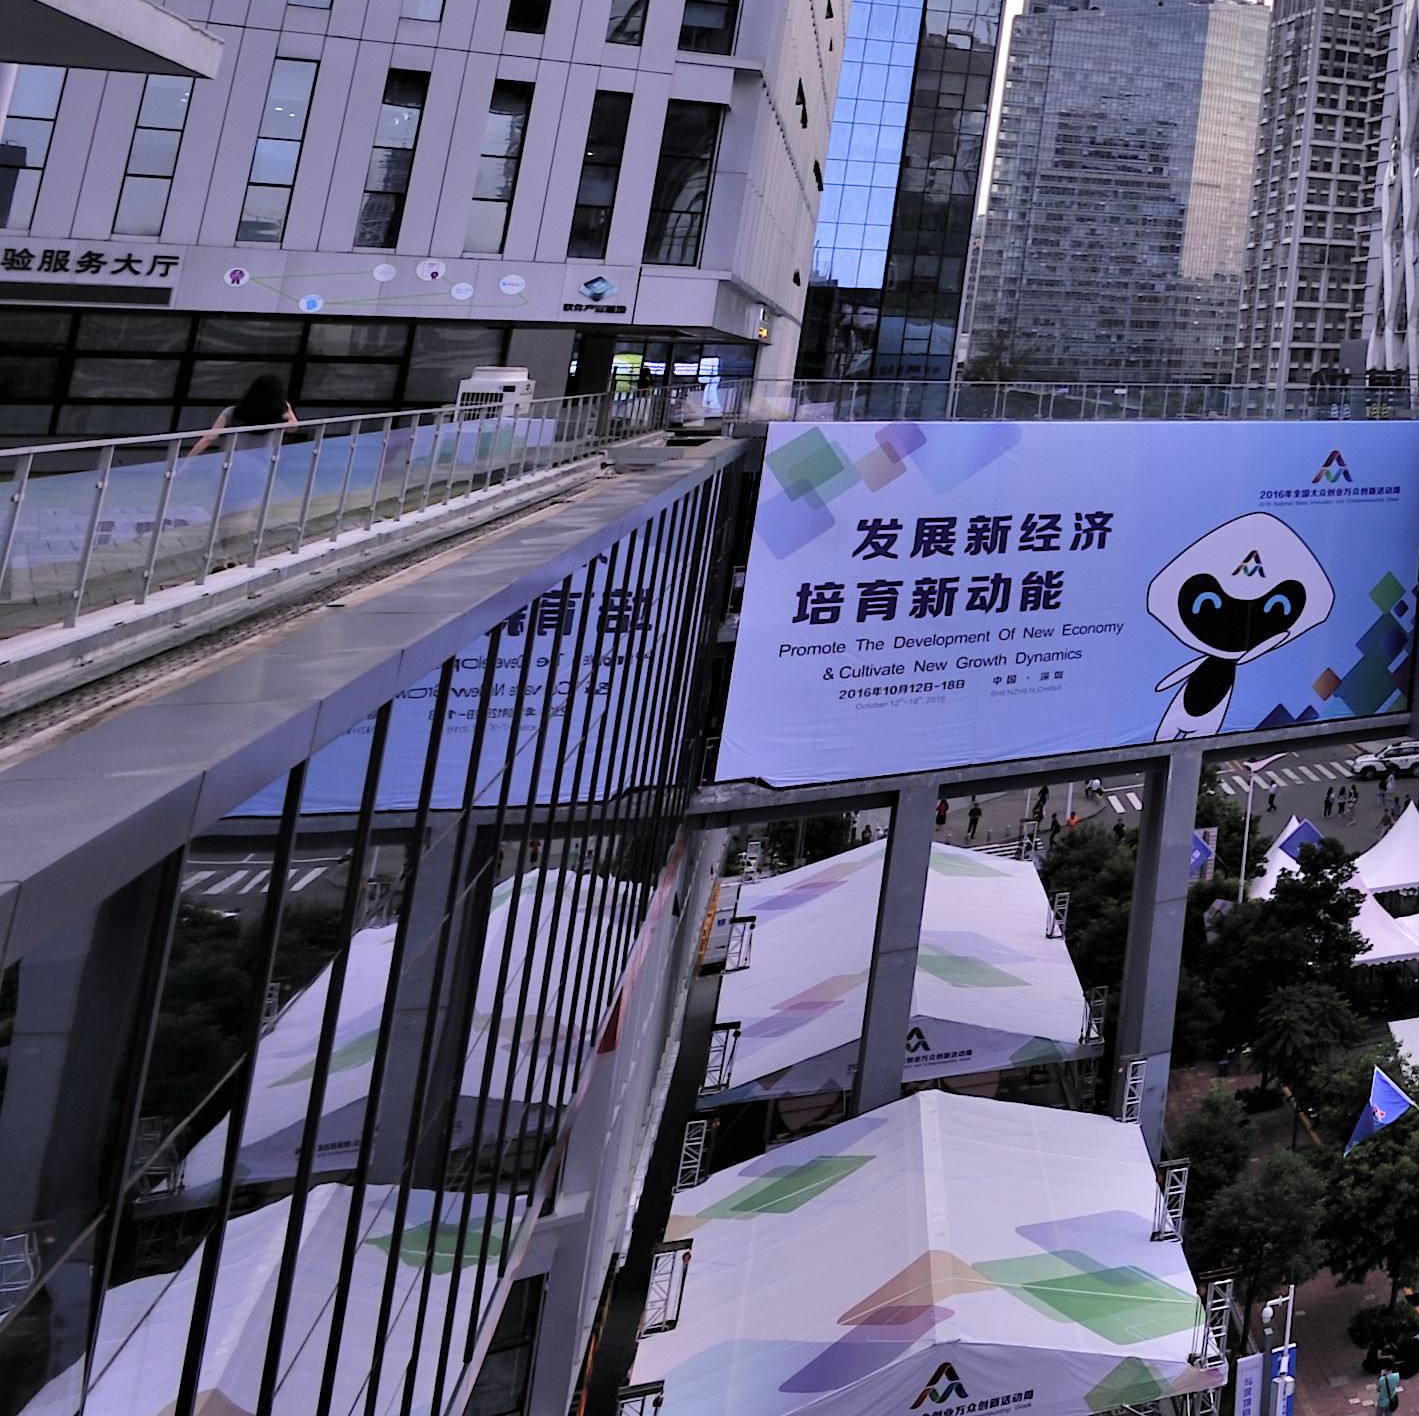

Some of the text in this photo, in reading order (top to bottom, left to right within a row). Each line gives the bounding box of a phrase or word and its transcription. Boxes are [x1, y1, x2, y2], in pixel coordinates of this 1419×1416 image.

[1, 248, 180, 277] 验服务大厅
[851, 511, 1115, 561] 发展新经济
[791, 570, 1066, 625] 培育新动能
[778, 621, 1125, 658] Promote The Development Of New Economy
[822, 648, 1083, 681] & Cultivate New Growth Dynamics
